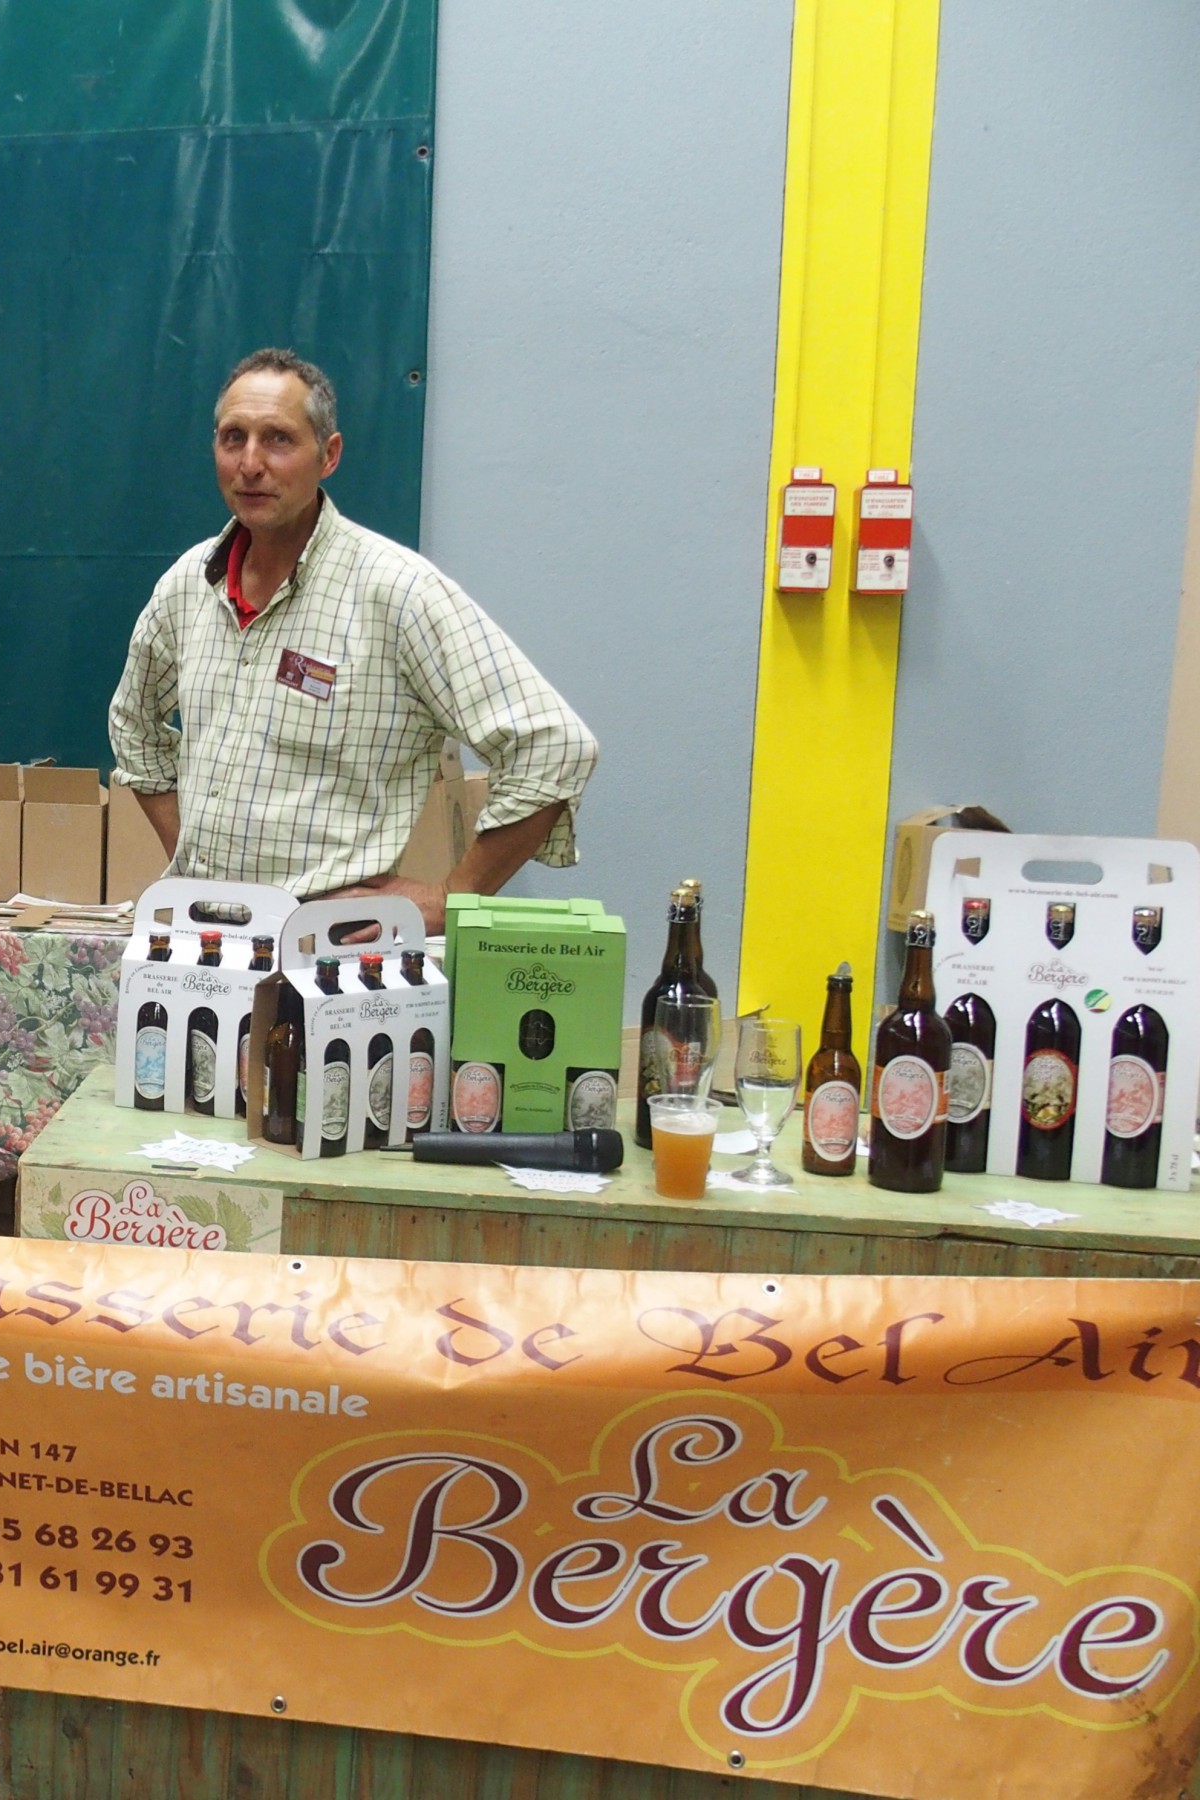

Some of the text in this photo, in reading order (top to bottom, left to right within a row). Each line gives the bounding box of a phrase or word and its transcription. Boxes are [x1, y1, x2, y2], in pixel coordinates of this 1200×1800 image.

[478, 940, 605, 957] Brasserie de Bel Air
[507, 970, 573, 1000] Bergère
[529, 965, 547, 980] La
[120, 1186, 162, 1218] La
[435, 1298, 584, 1371] de
[637, 1306, 944, 1385] Bel
[24, 1352, 136, 1395] bière
[151, 1371, 370, 1417] artisanale
[30, 1442, 78, 1463] 147
[573, 1414, 828, 1530] La
[34, 1523, 79, 1550] 68
[91, 1527, 137, 1553] 26
[148, 1533, 194, 1559] 93
[39, 1565, 78, 1592] 61
[95, 1570, 140, 1599] 99
[152, 1575, 193, 1603] 31
[296, 1450, 1170, 1738] Bergère
